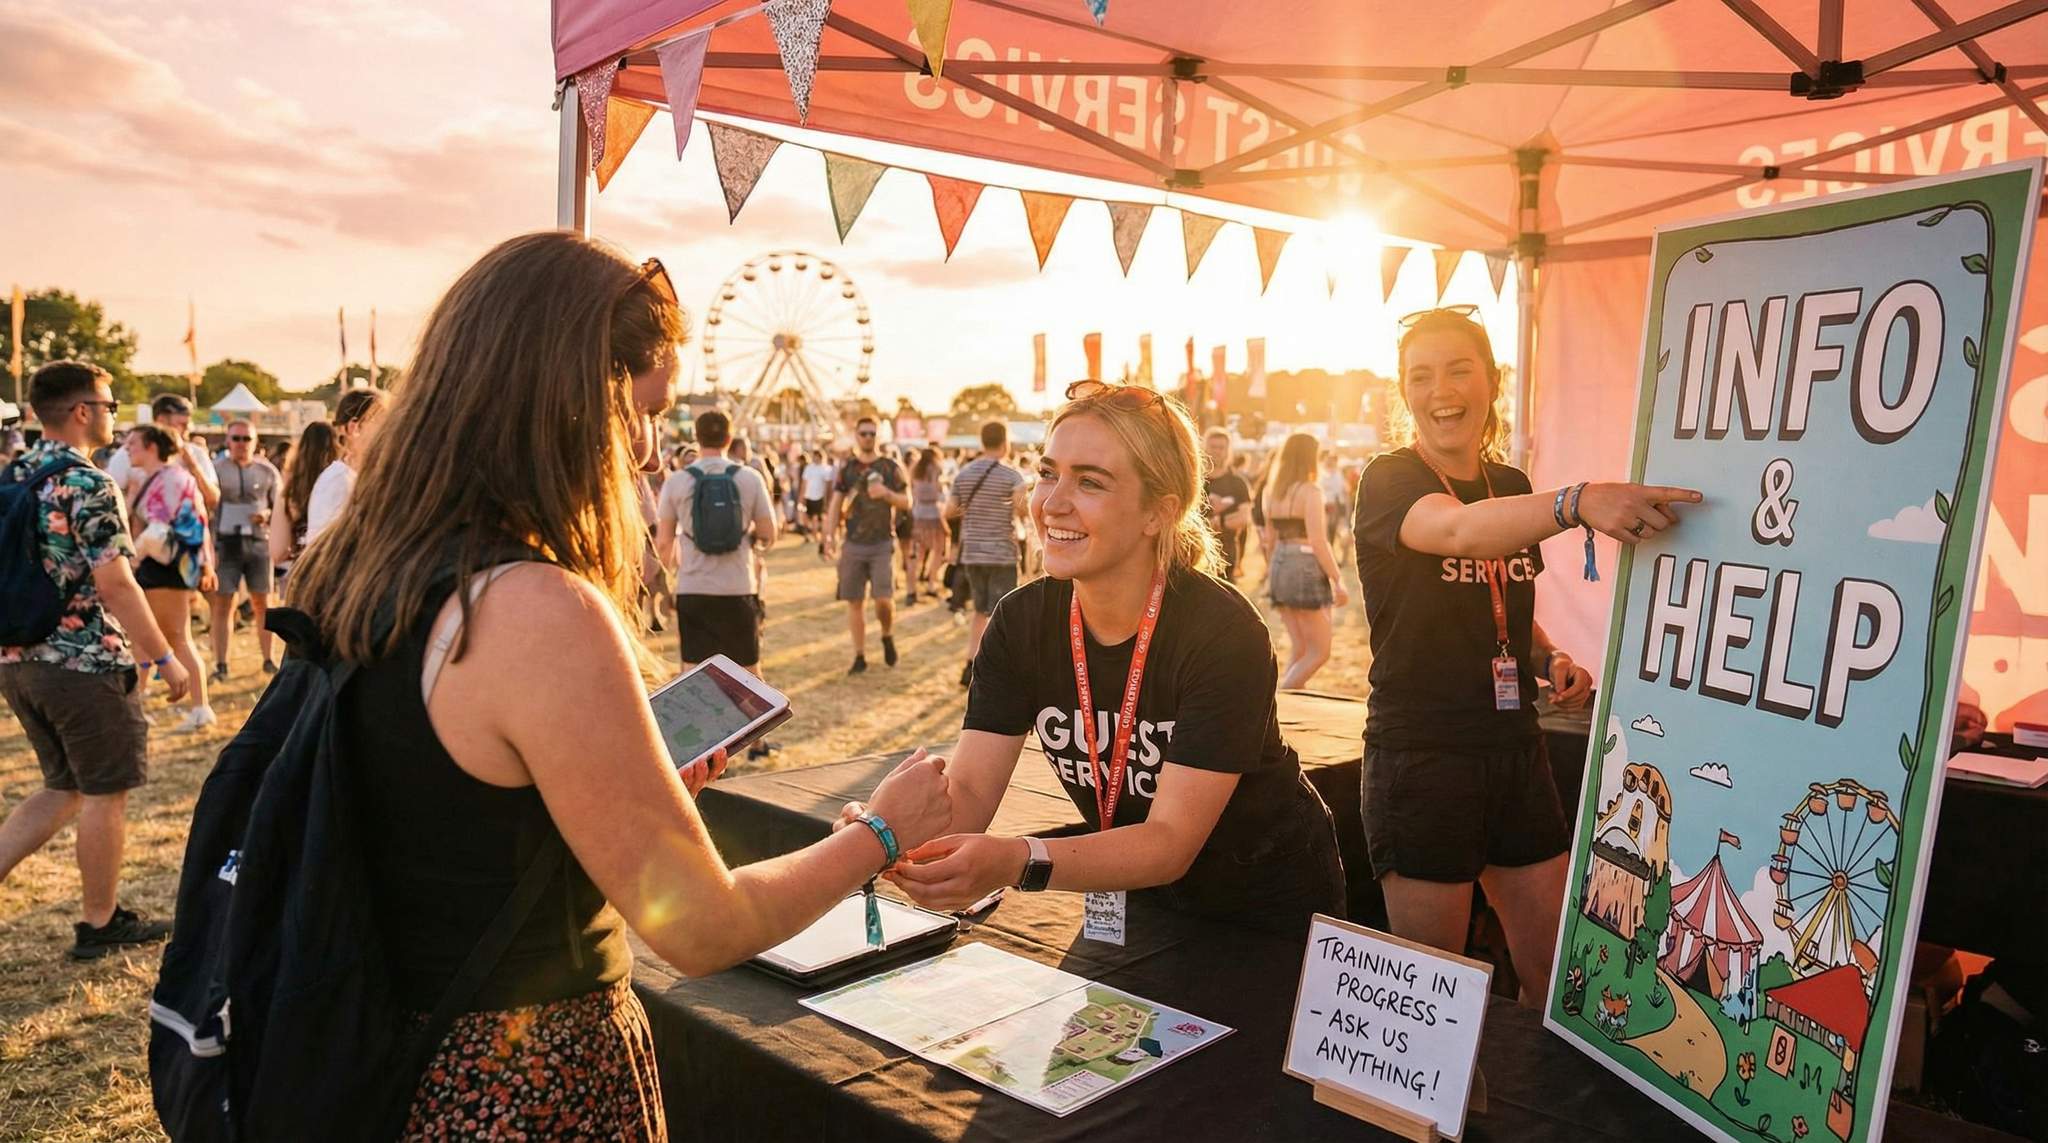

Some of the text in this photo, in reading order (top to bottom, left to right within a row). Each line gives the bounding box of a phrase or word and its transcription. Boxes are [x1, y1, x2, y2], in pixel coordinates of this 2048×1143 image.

[1674, 278, 1946, 445] INFO
[1751, 458, 1800, 546] &
[1639, 553, 1903, 729] HELP
[1036, 706, 1176, 767] GUEST
[1317, 936, 1458, 998] TRAINING IN
[1328, 1008, 1370, 1040] ASK
[1382, 1027, 1409, 1053] US
[1336, 972, 1438, 1027] PROGRESS
